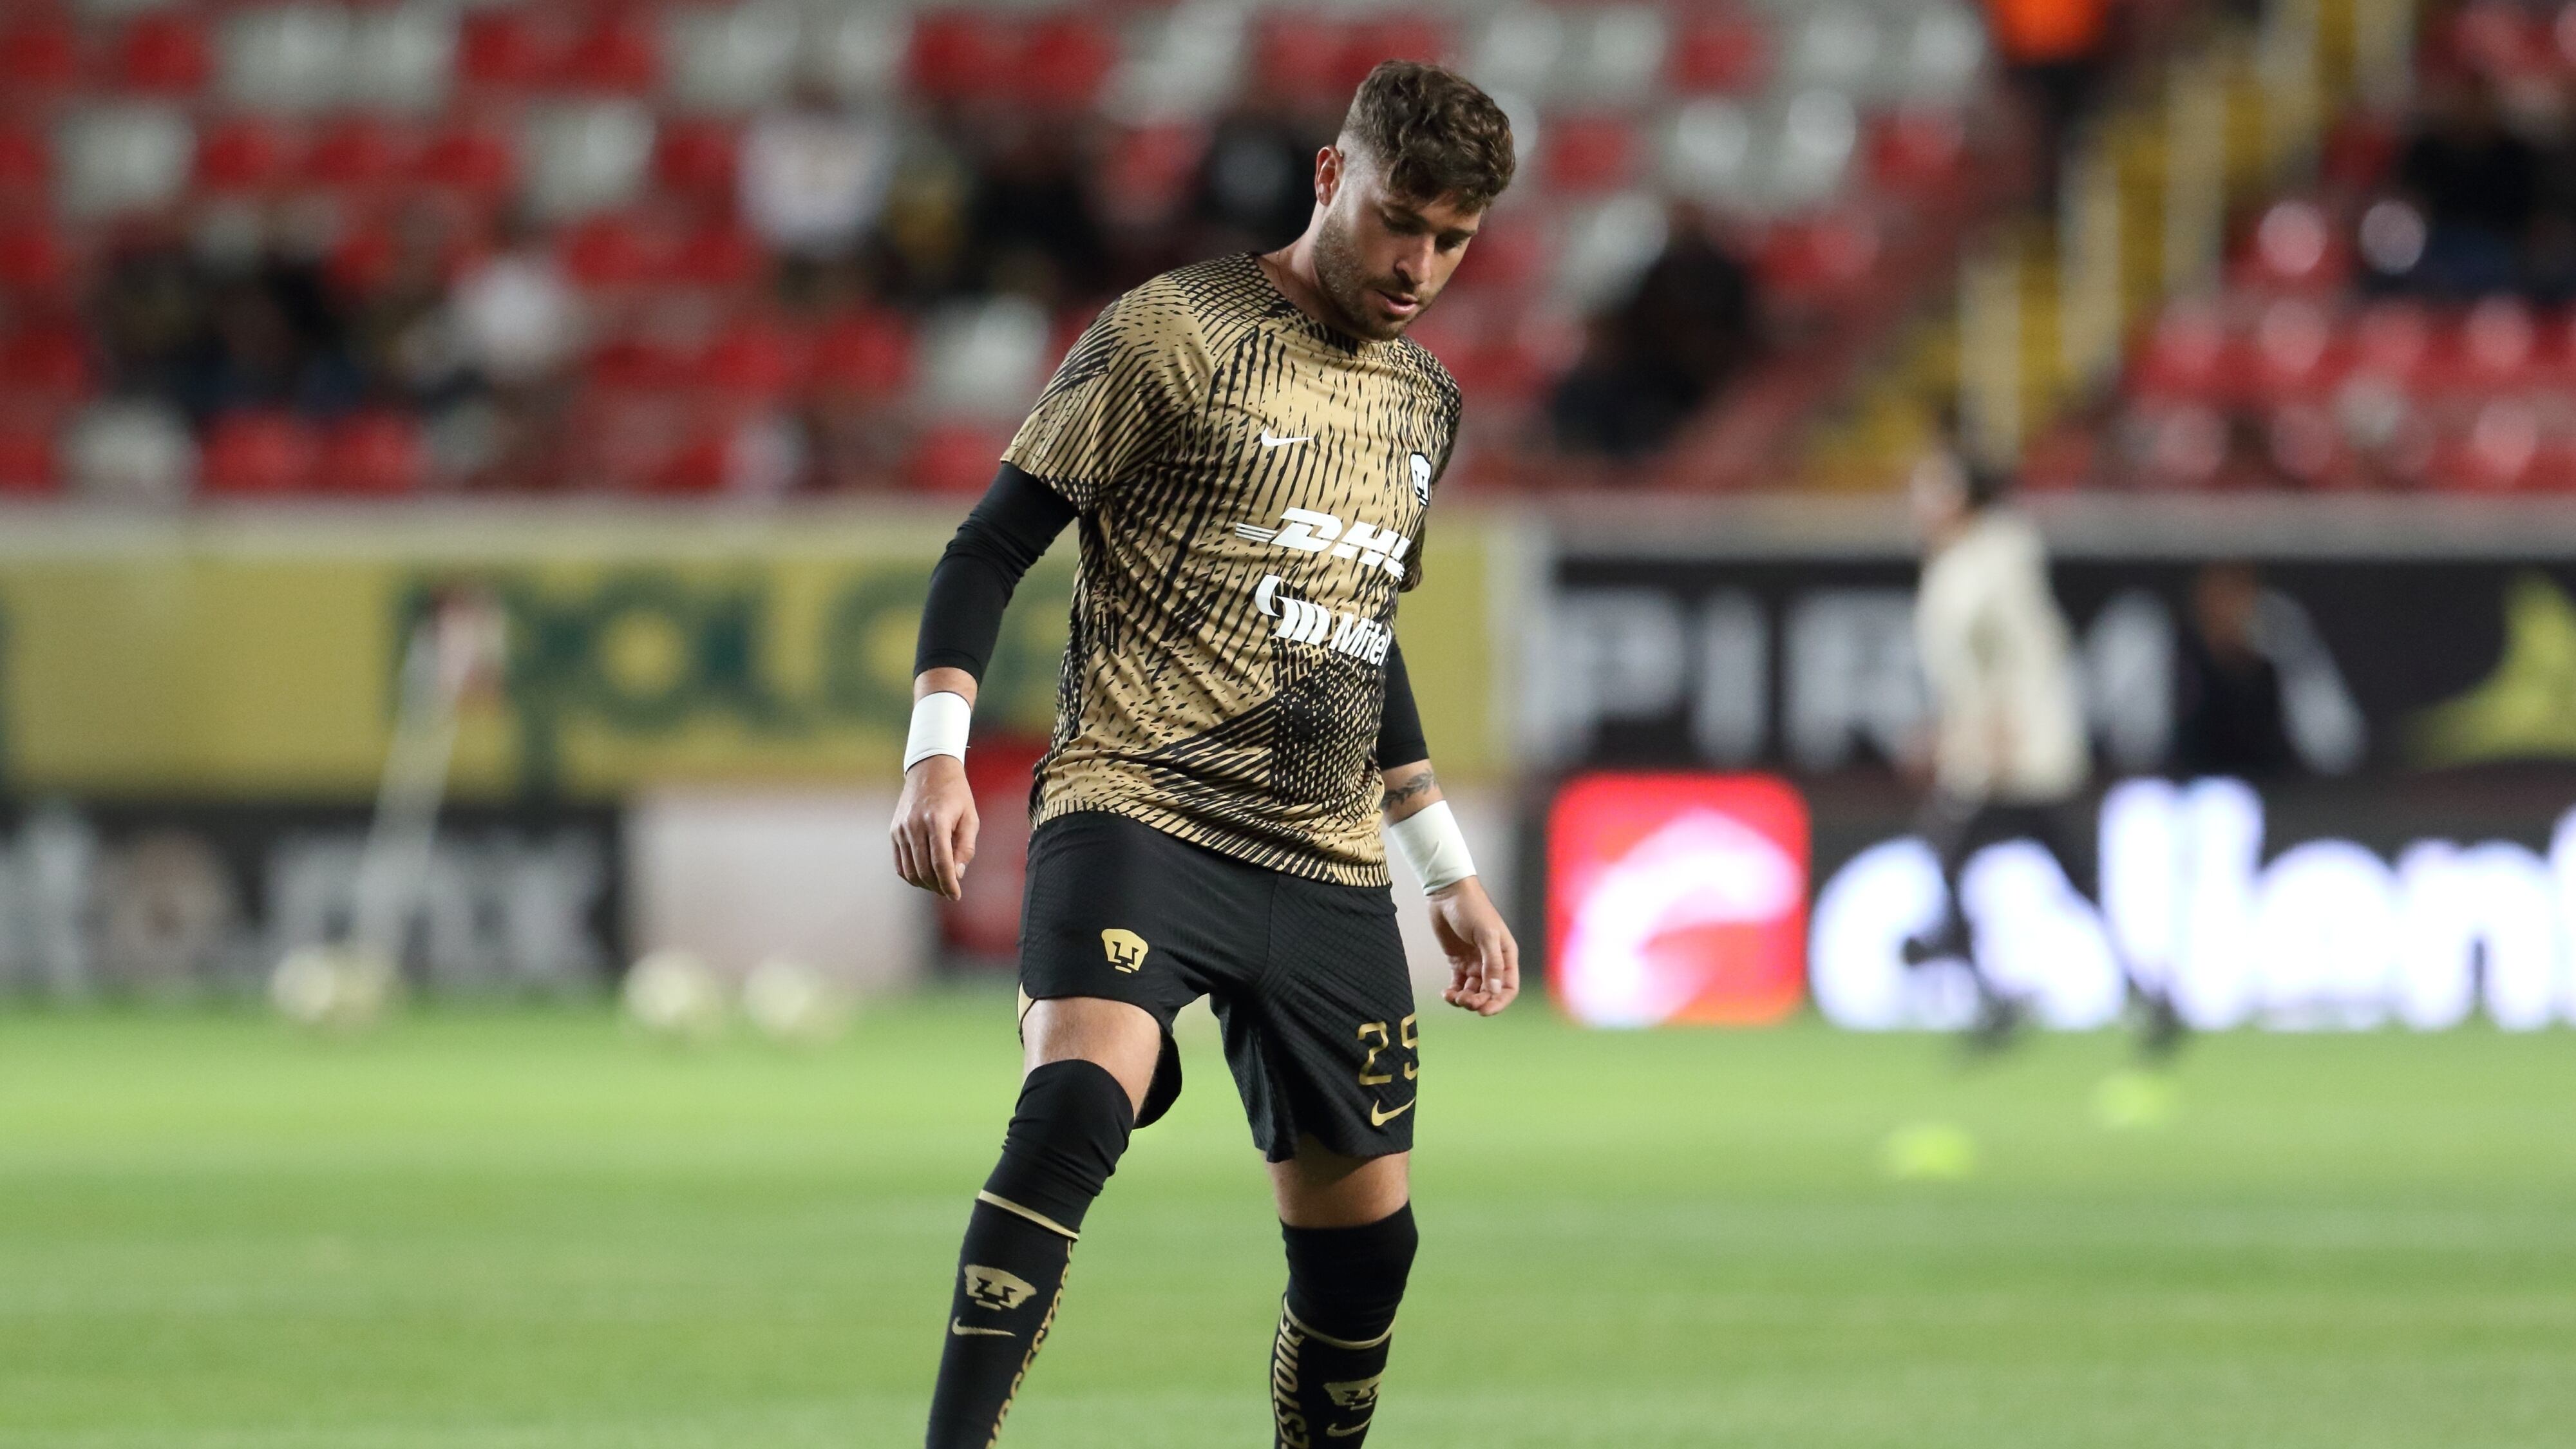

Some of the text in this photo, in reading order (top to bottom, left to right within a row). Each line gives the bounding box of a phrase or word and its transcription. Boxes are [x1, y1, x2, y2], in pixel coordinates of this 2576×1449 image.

[1270, 507, 1411, 579] DHL
[1328, 612, 1392, 667] Mitel
[1273, 1311, 1310, 1449] ESTONE
